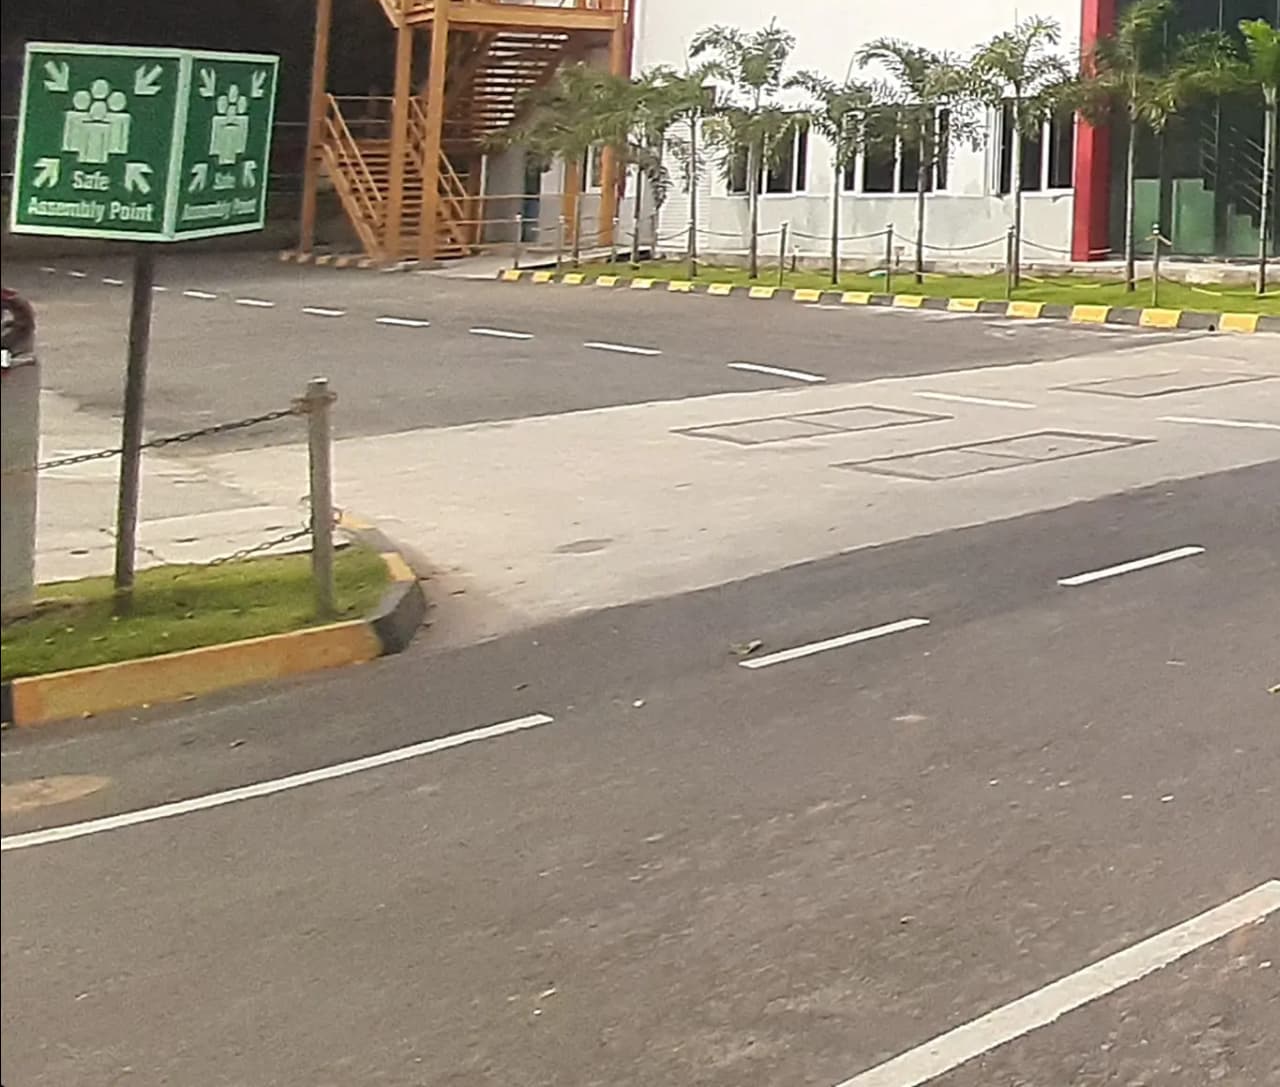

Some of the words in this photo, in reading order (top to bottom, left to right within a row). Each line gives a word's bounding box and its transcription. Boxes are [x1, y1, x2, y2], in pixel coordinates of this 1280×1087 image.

[72, 170, 110, 191] Safe
[28, 196, 105, 223] Assembly
[108, 201, 154, 222] Point
